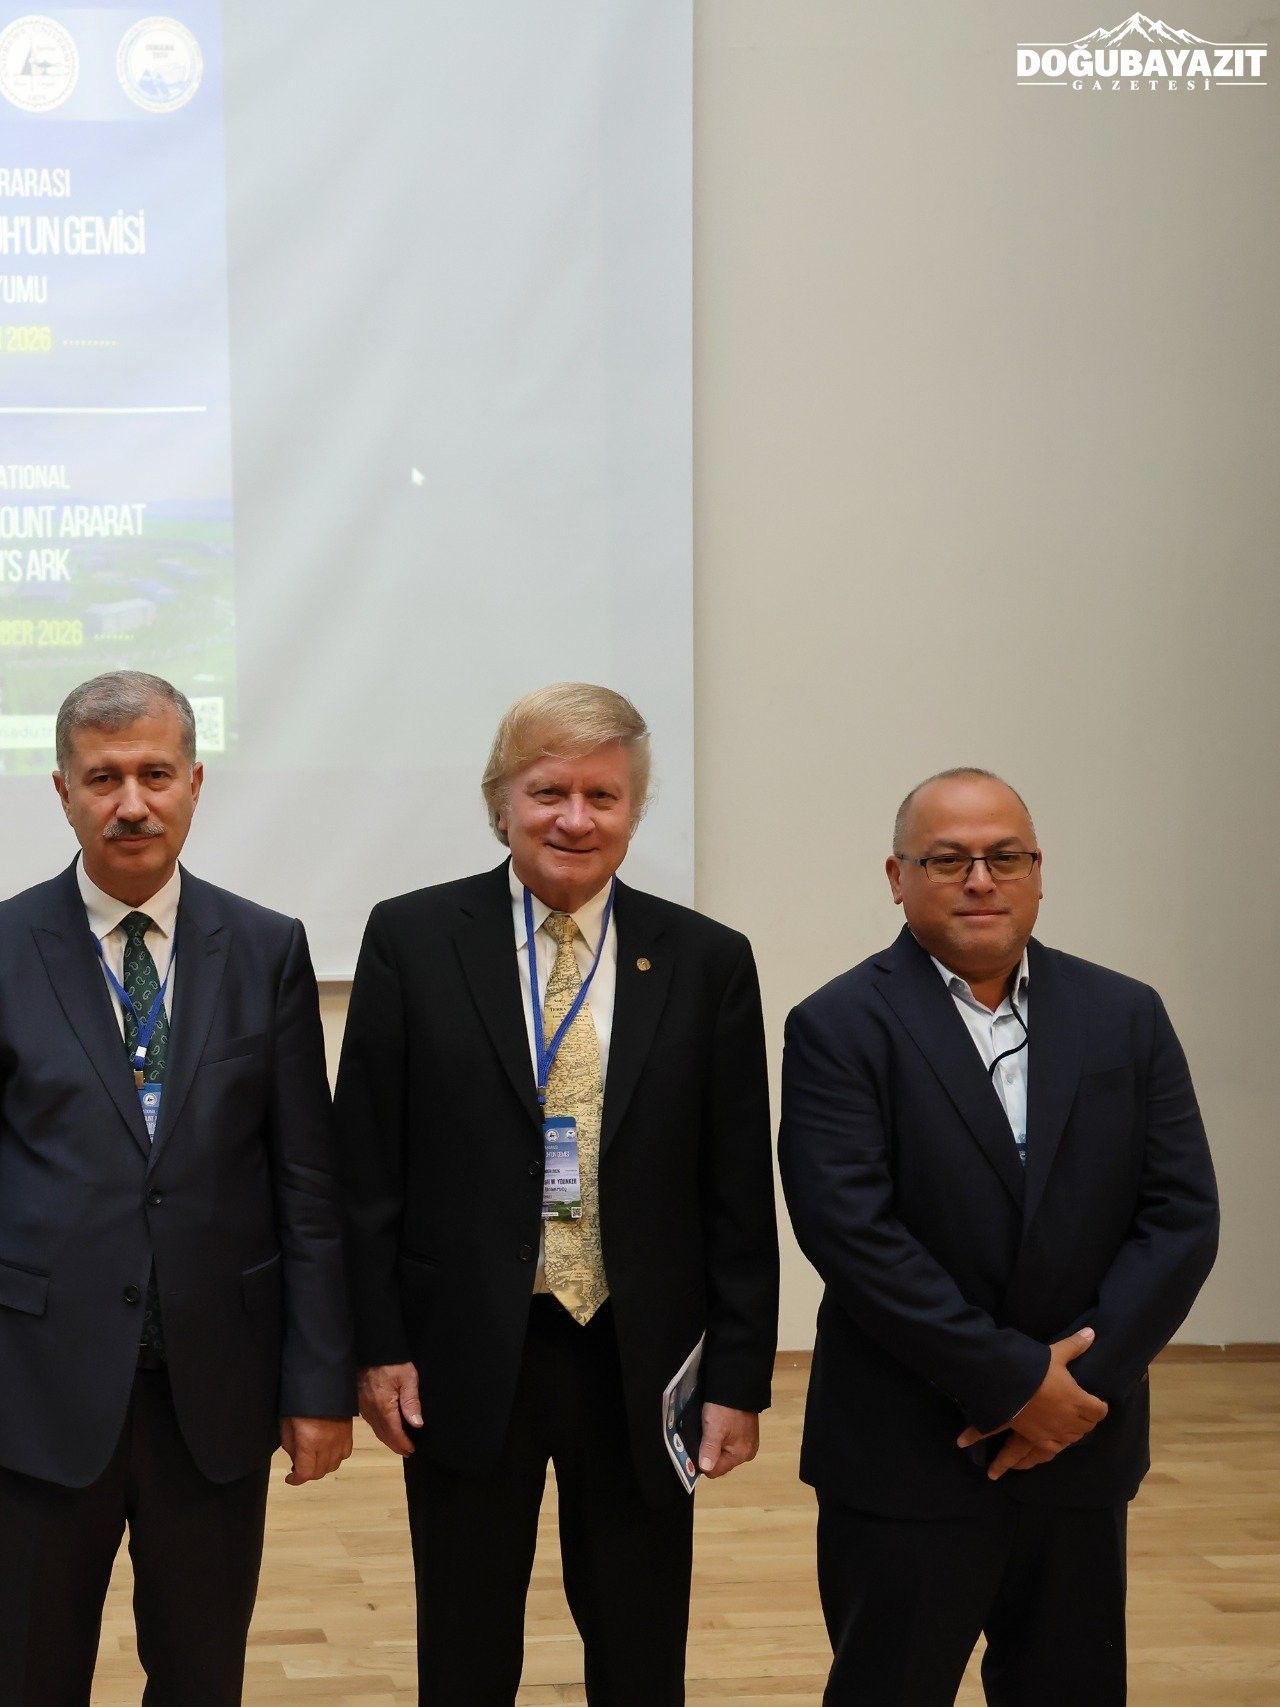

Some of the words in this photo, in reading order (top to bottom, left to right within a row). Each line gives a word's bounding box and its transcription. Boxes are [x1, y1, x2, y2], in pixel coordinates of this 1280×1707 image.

[63, 208, 146, 255] GEMİSİ
[6, 325, 53, 352] 2026
[59, 503, 147, 538] ARARAT
[25, 548, 71, 583] ARK
[38, 618, 84, 647] 2026
